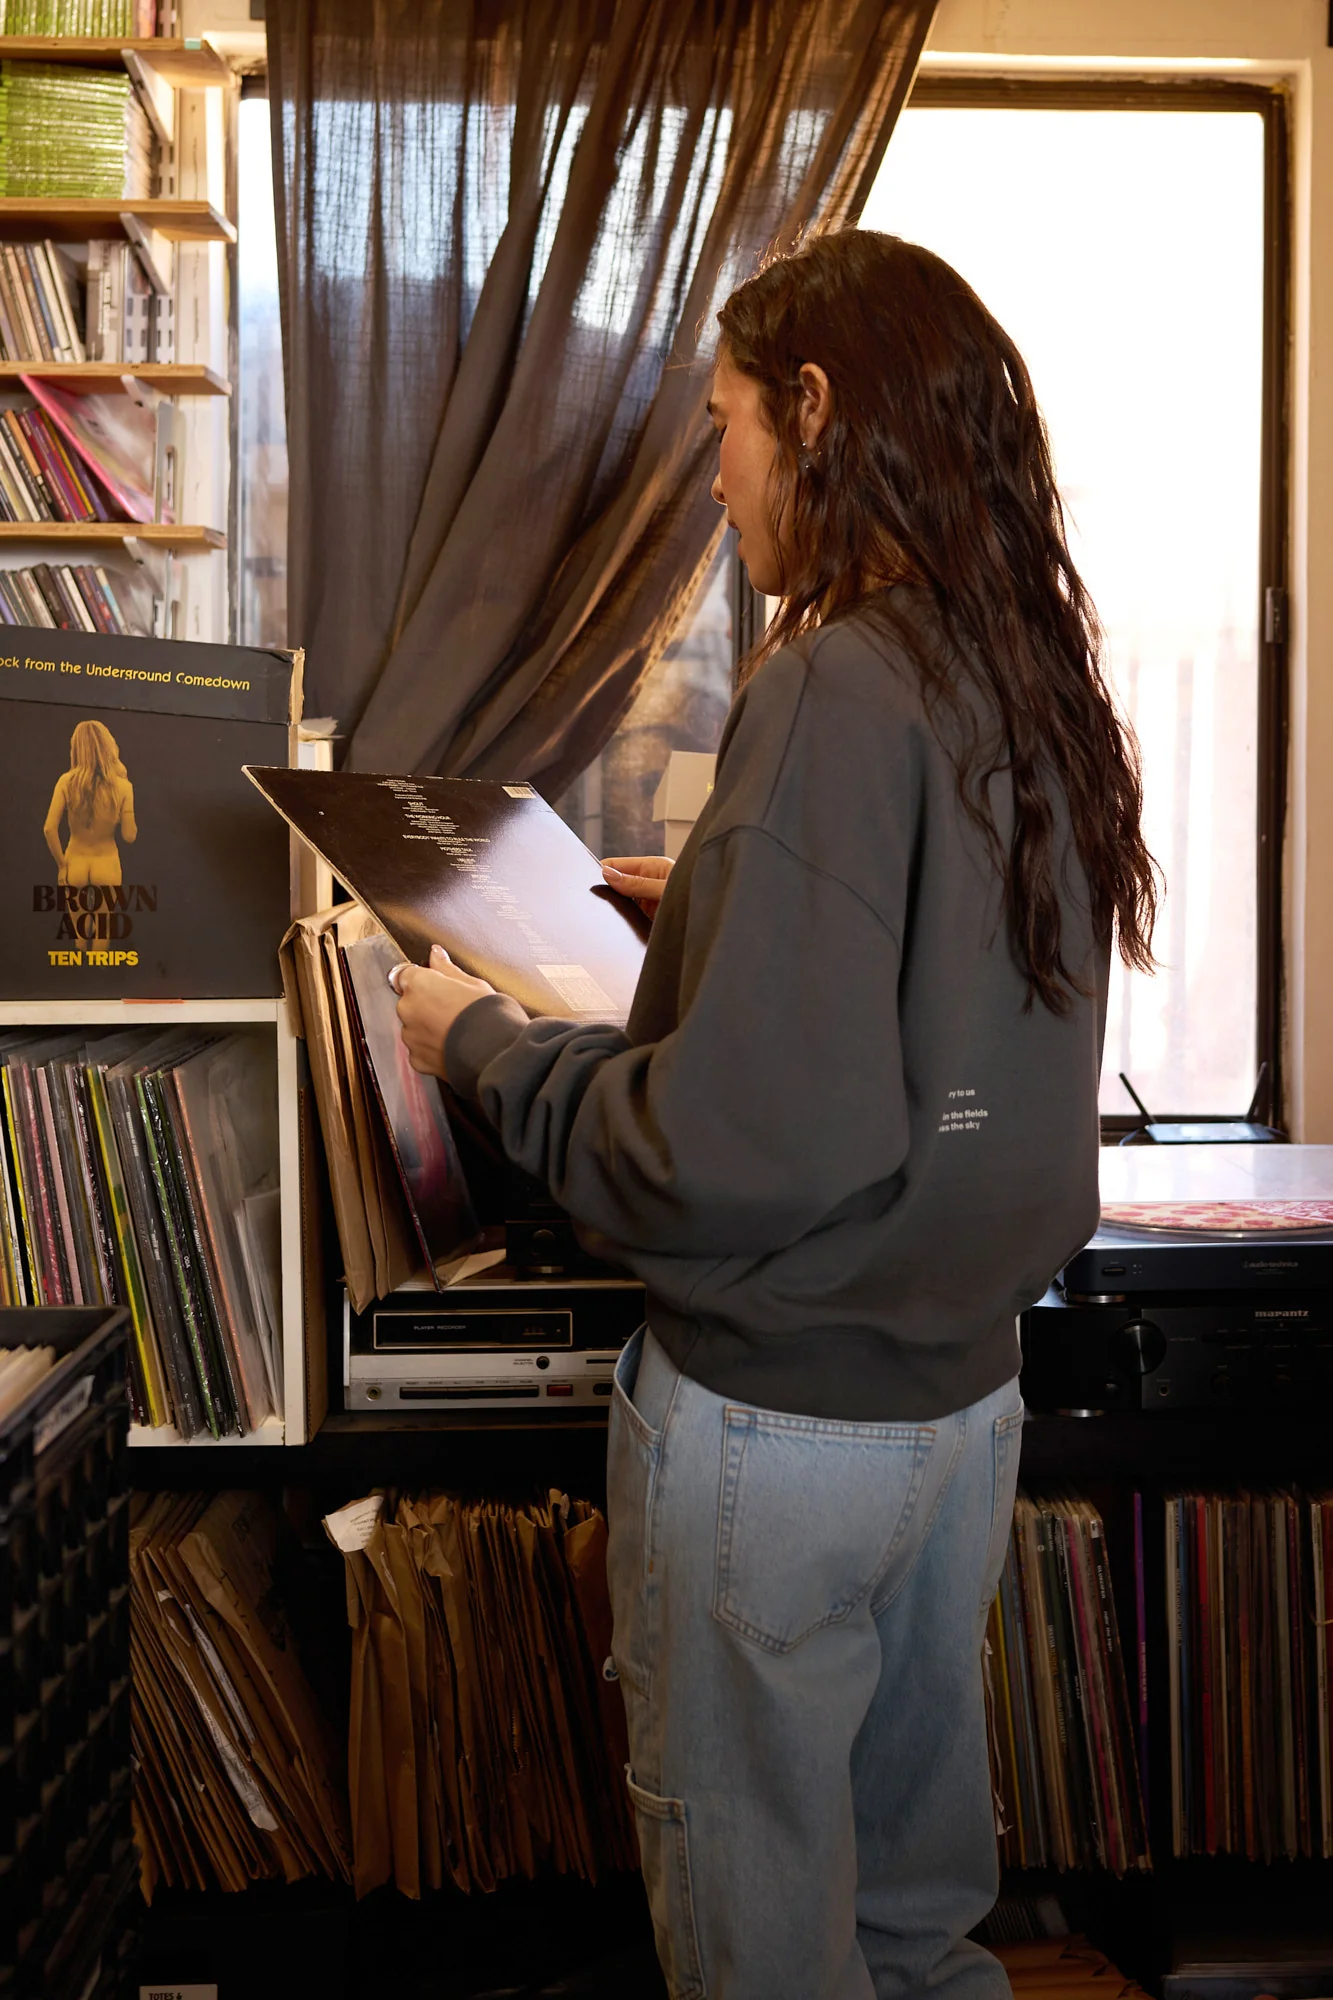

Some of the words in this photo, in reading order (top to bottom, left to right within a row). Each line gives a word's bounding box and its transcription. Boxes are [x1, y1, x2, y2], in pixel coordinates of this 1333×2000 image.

[24, 657, 55, 672] from
[60, 661, 82, 674] the
[86, 663, 171, 683] Underground
[176, 671, 250, 691] Comedown
[32, 884, 158, 912] BROWN
[56, 912, 133, 940] ACID
[48, 951, 82, 966] TEN
[86, 951, 139, 966] TRIPS
[951, 1111, 964, 1119] the
[964, 1109, 988, 1118] fields
[951, 1122, 964, 1130] the
[965, 1121, 980, 1130] sky
[1254, 1310, 1310, 1318] marantz
[148, 1992, 174, 2000] TOTES
[176, 1992, 183, 2000] &
